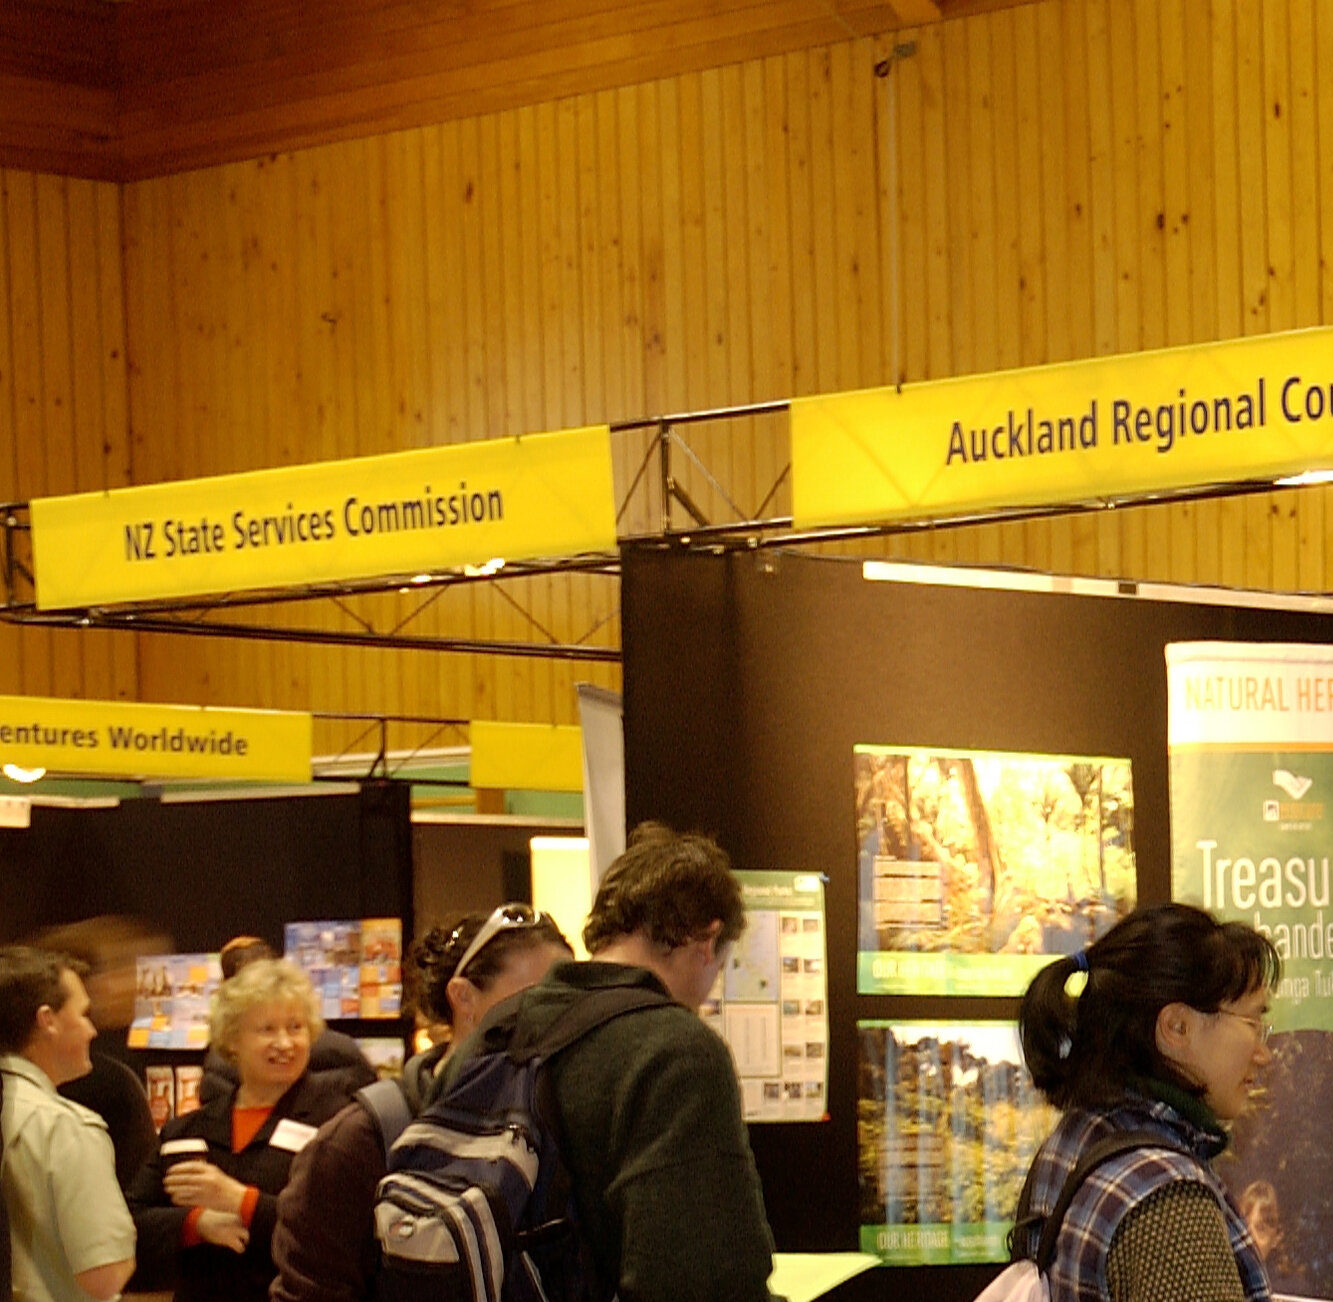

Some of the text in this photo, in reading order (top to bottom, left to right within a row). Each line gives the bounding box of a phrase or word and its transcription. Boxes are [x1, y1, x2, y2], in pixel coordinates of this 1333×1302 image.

[946, 398, 1099, 468] Auckland
[1111, 378, 1268, 454] Regional
[125, 480, 504, 562] NZ State Services Commission
[1185, 676, 1290, 714] NATURAL
[108, 726, 248, 756] Worldwide
